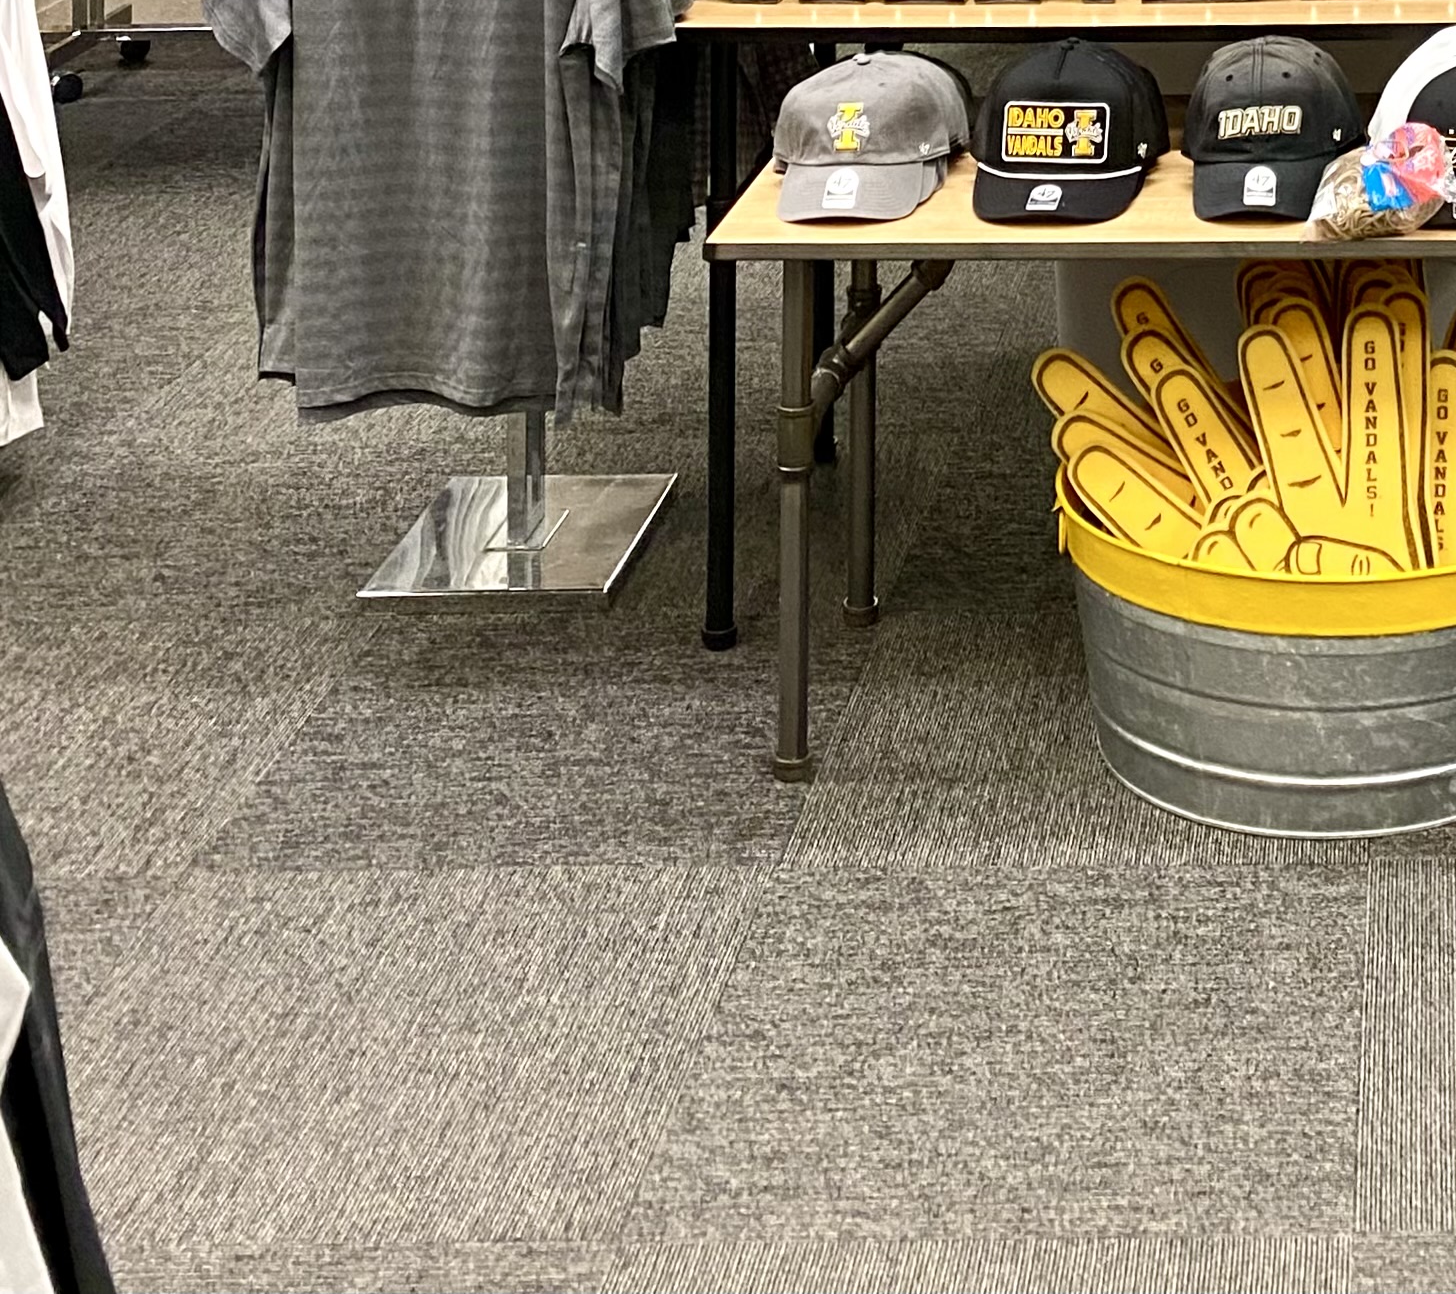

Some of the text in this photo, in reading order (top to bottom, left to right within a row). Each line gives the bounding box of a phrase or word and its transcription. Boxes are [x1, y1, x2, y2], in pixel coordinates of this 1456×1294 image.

[1008, 106, 1065, 128] IDAHO
[1218, 105, 1303, 140] IDAHO
[1007, 134, 1063, 156] VANDALS
[1436, 389, 1449, 420] GO
[1177, 398, 1234, 491] GO VAND
[1364, 340, 1379, 517] GO VANDALS!
